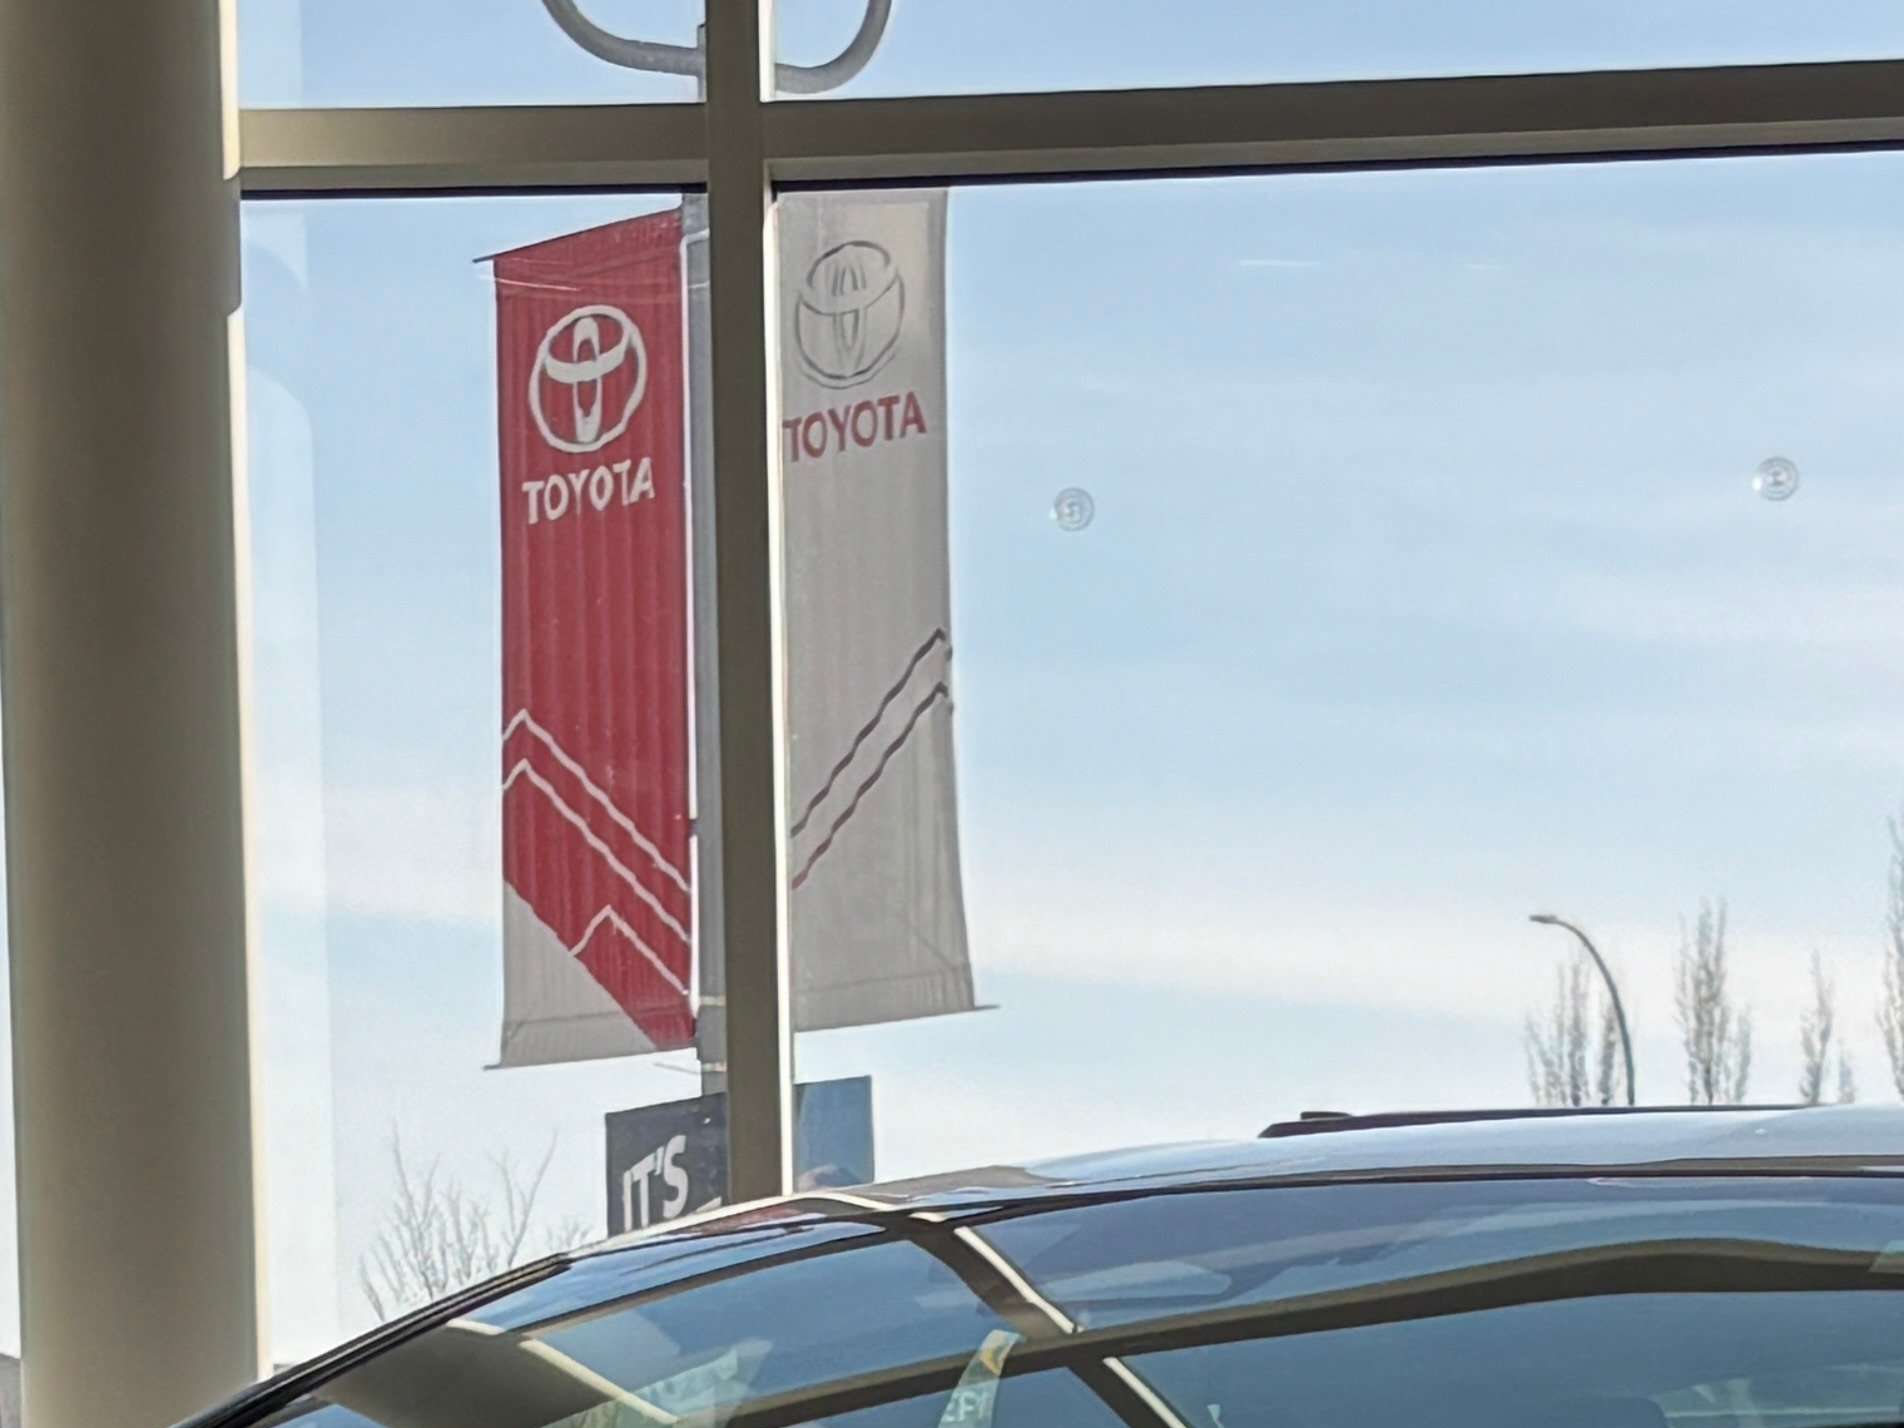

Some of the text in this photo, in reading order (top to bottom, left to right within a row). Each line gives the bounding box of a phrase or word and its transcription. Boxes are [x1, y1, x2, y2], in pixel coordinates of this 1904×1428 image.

[782, 392, 927, 462] TOYOTA
[522, 457, 655, 525] TOYOTA
[623, 1134, 689, 1232] IT'S
